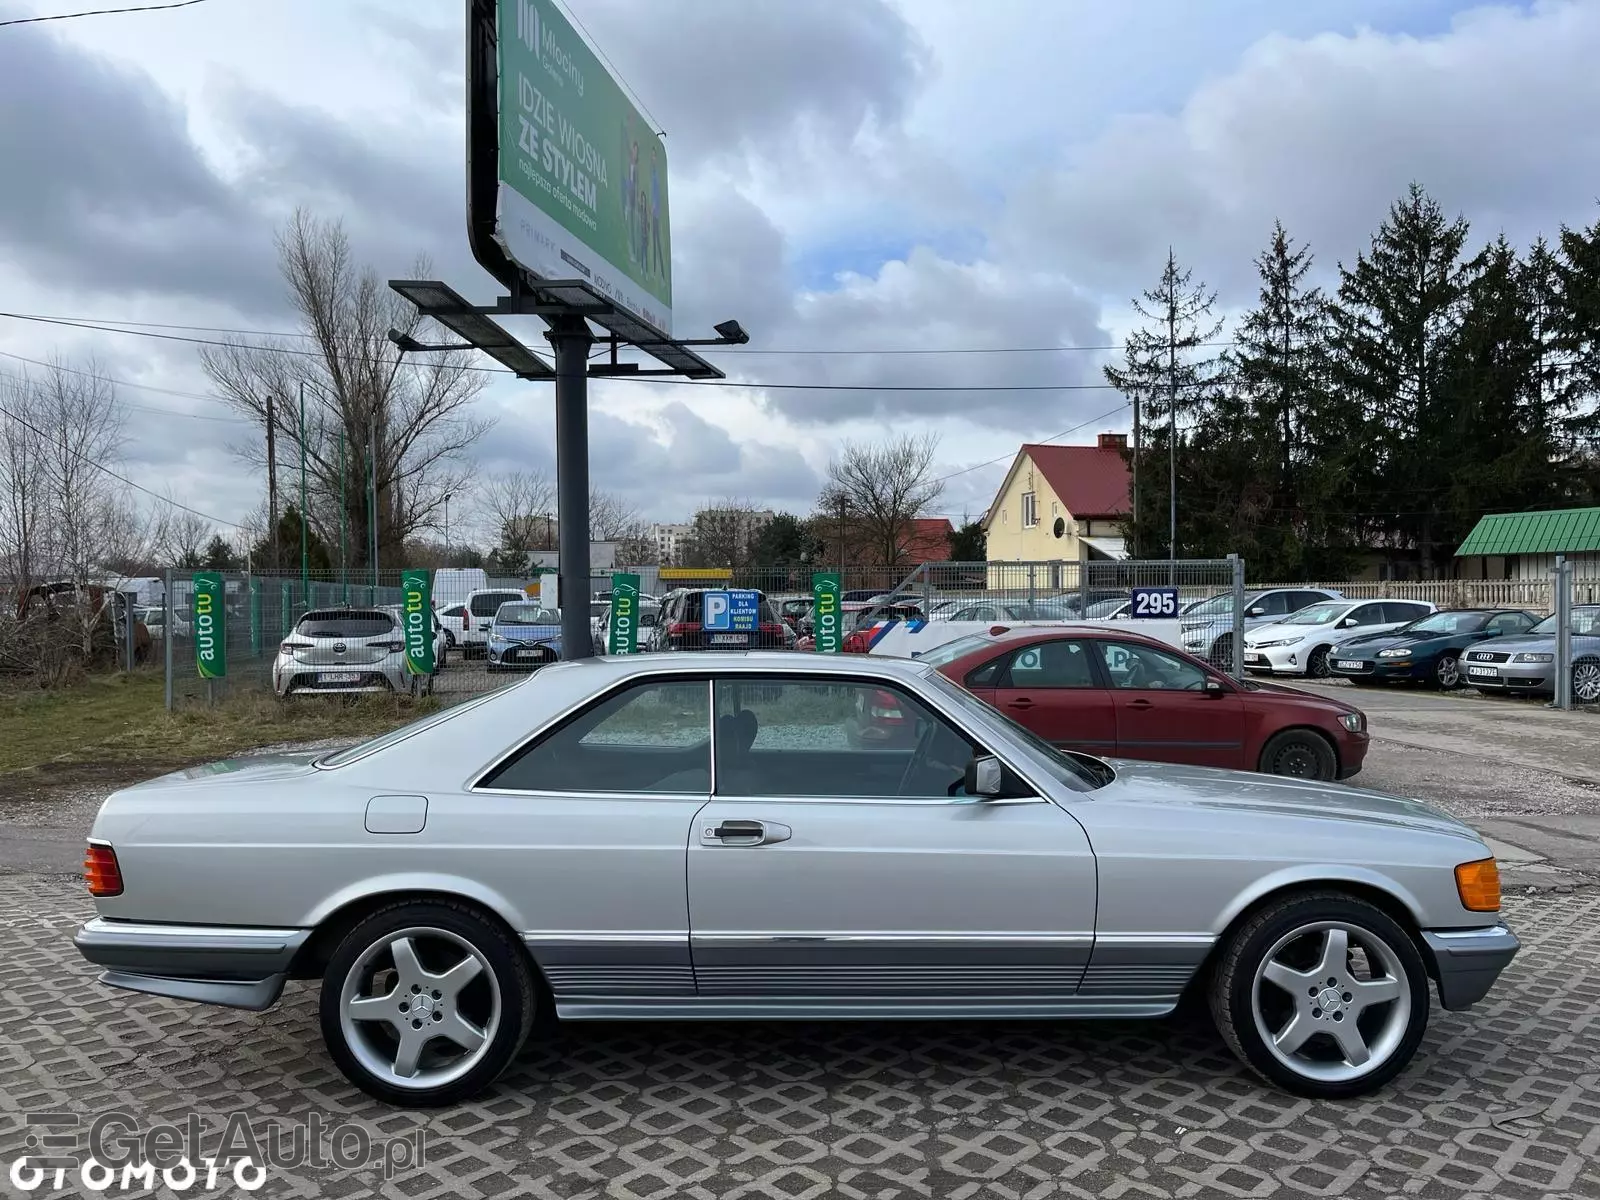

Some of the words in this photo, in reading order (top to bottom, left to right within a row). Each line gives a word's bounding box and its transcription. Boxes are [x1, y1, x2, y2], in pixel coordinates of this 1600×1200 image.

[518, 71, 554, 135] IDZIE
[518, 113, 539, 161] ZE
[542, 138, 597, 212] STYLEM
[197, 593, 215, 660] autotu
[406, 591, 425, 658] autotu
[707, 597, 726, 624] P
[819, 593, 837, 653] utotu
[1136, 592, 1175, 614] 295
